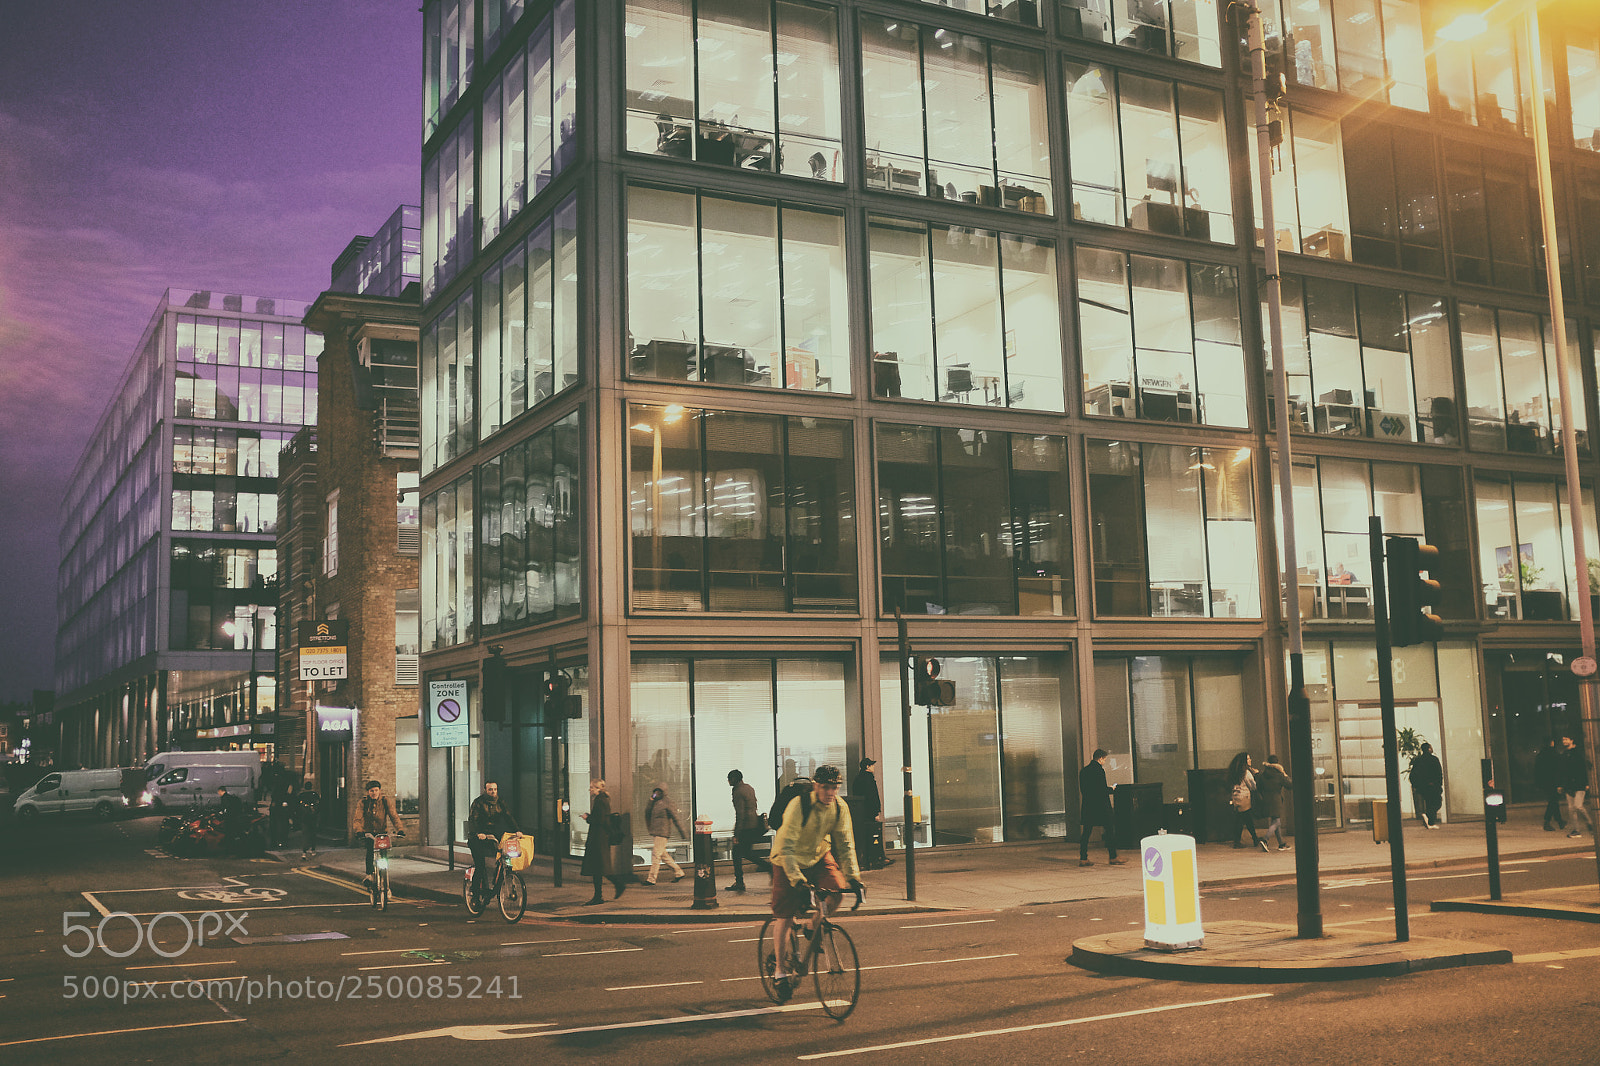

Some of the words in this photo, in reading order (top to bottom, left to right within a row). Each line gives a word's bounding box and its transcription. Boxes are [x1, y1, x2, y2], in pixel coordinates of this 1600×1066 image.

[303, 667, 319, 677] TO
[323, 666, 344, 676] LET
[431, 682, 465, 690] Controlled
[436, 689, 460, 697] ZONE
